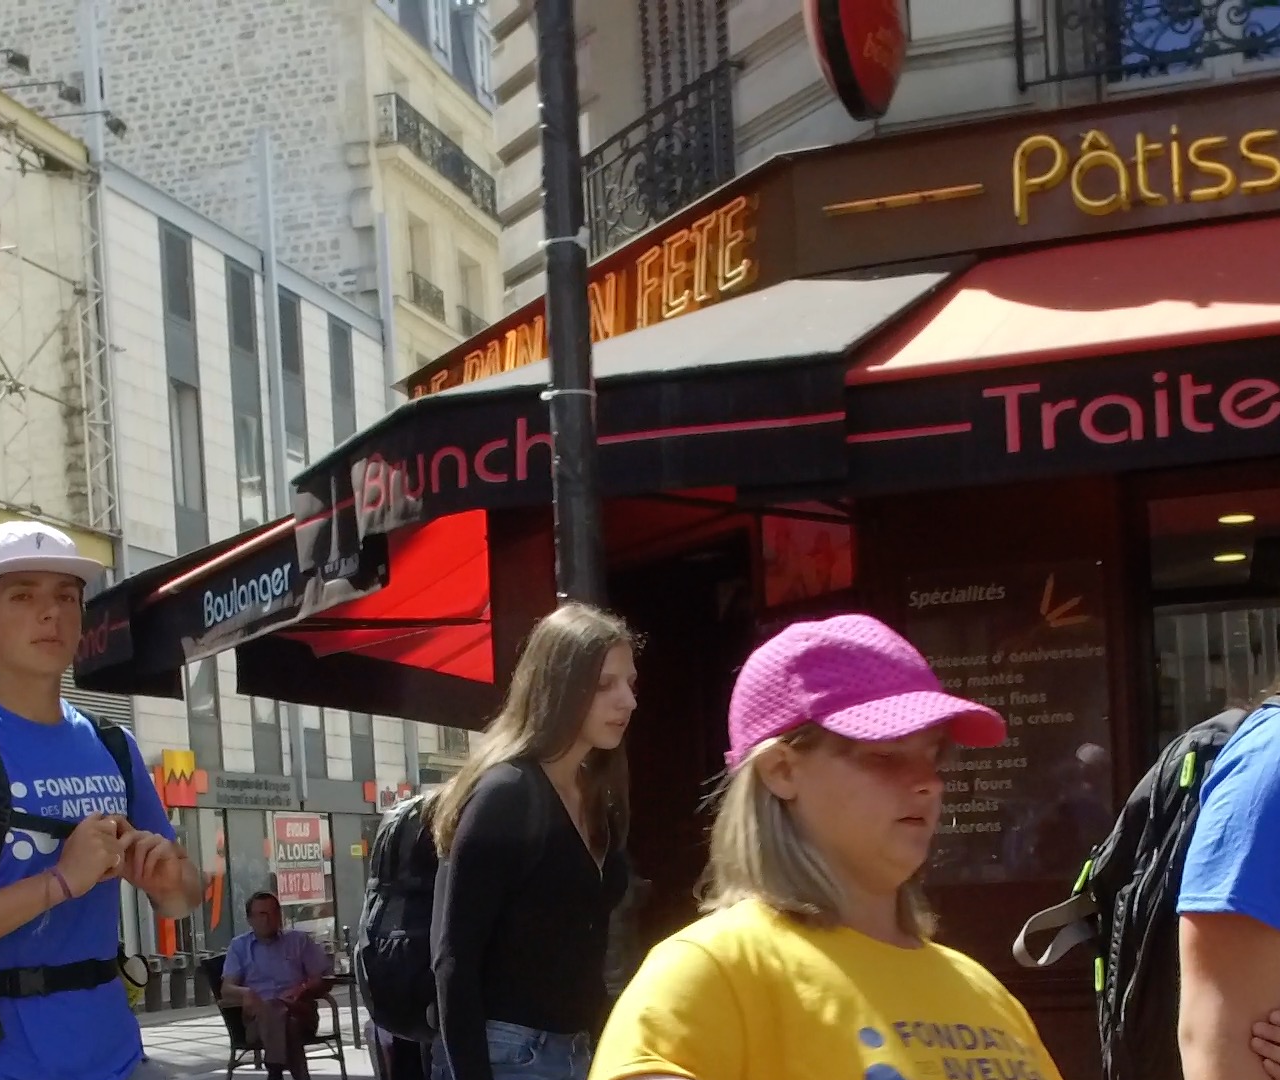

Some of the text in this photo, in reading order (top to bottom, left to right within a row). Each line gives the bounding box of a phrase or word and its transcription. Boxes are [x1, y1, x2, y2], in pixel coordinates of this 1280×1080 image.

[359, 417, 556, 513] Brunch
[202, 561, 293, 630] Boulanger
[33, 775, 127, 799] FONDATION
[41, 804, 61, 818] DES
[278, 842, 321, 860] A LOUER
